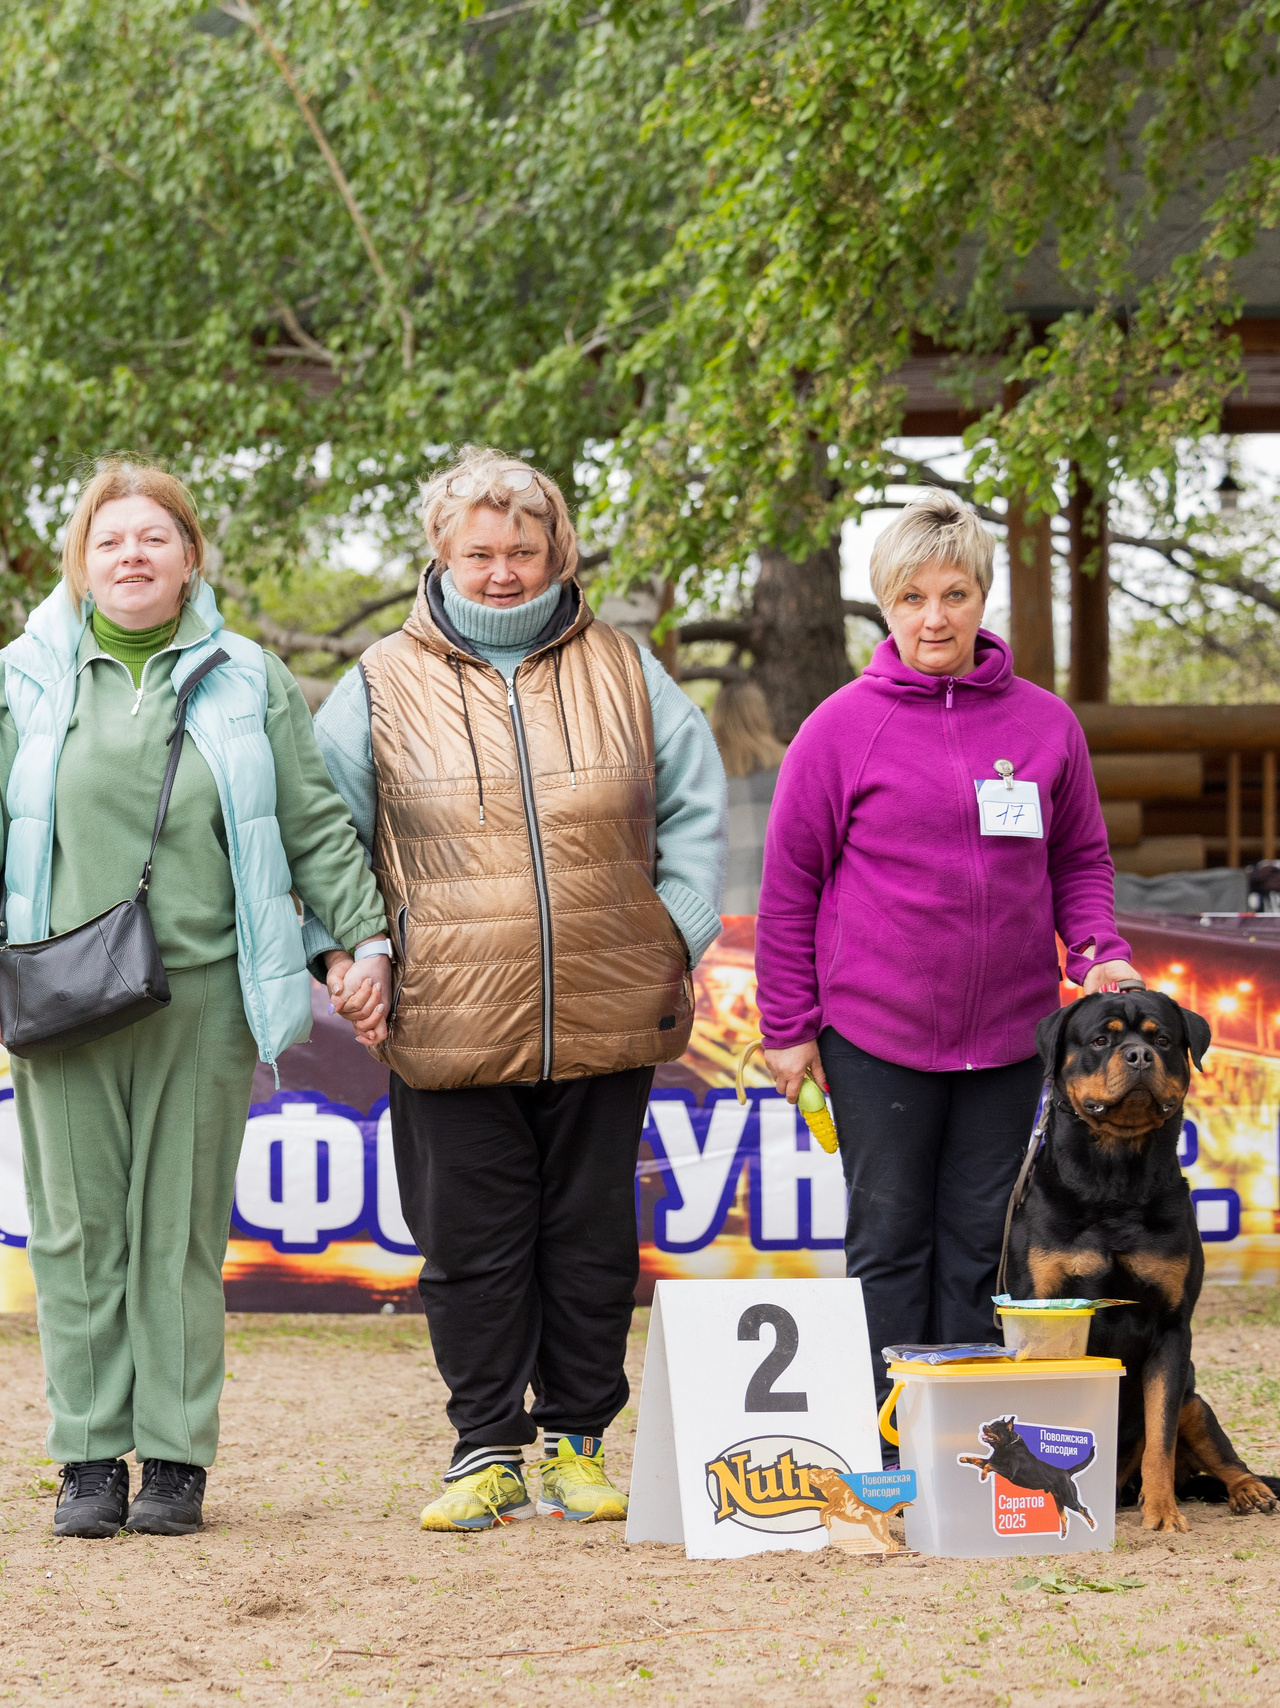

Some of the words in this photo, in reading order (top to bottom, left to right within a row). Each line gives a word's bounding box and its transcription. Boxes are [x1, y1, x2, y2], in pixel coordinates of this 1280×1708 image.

[996, 804, 1025, 826] 17
[737, 1303, 809, 1413] 2
[1040, 1429, 1088, 1445] Поволжская
[1040, 1442, 1078, 1456] Рапсодия
[705, 1449, 842, 1525] Nutr
[861, 1474, 911, 1485] Поволжская
[862, 1487, 901, 1498] Рапсодия
[998, 1495, 1045, 1512] Саратов
[998, 1513, 1027, 1529] 2025
